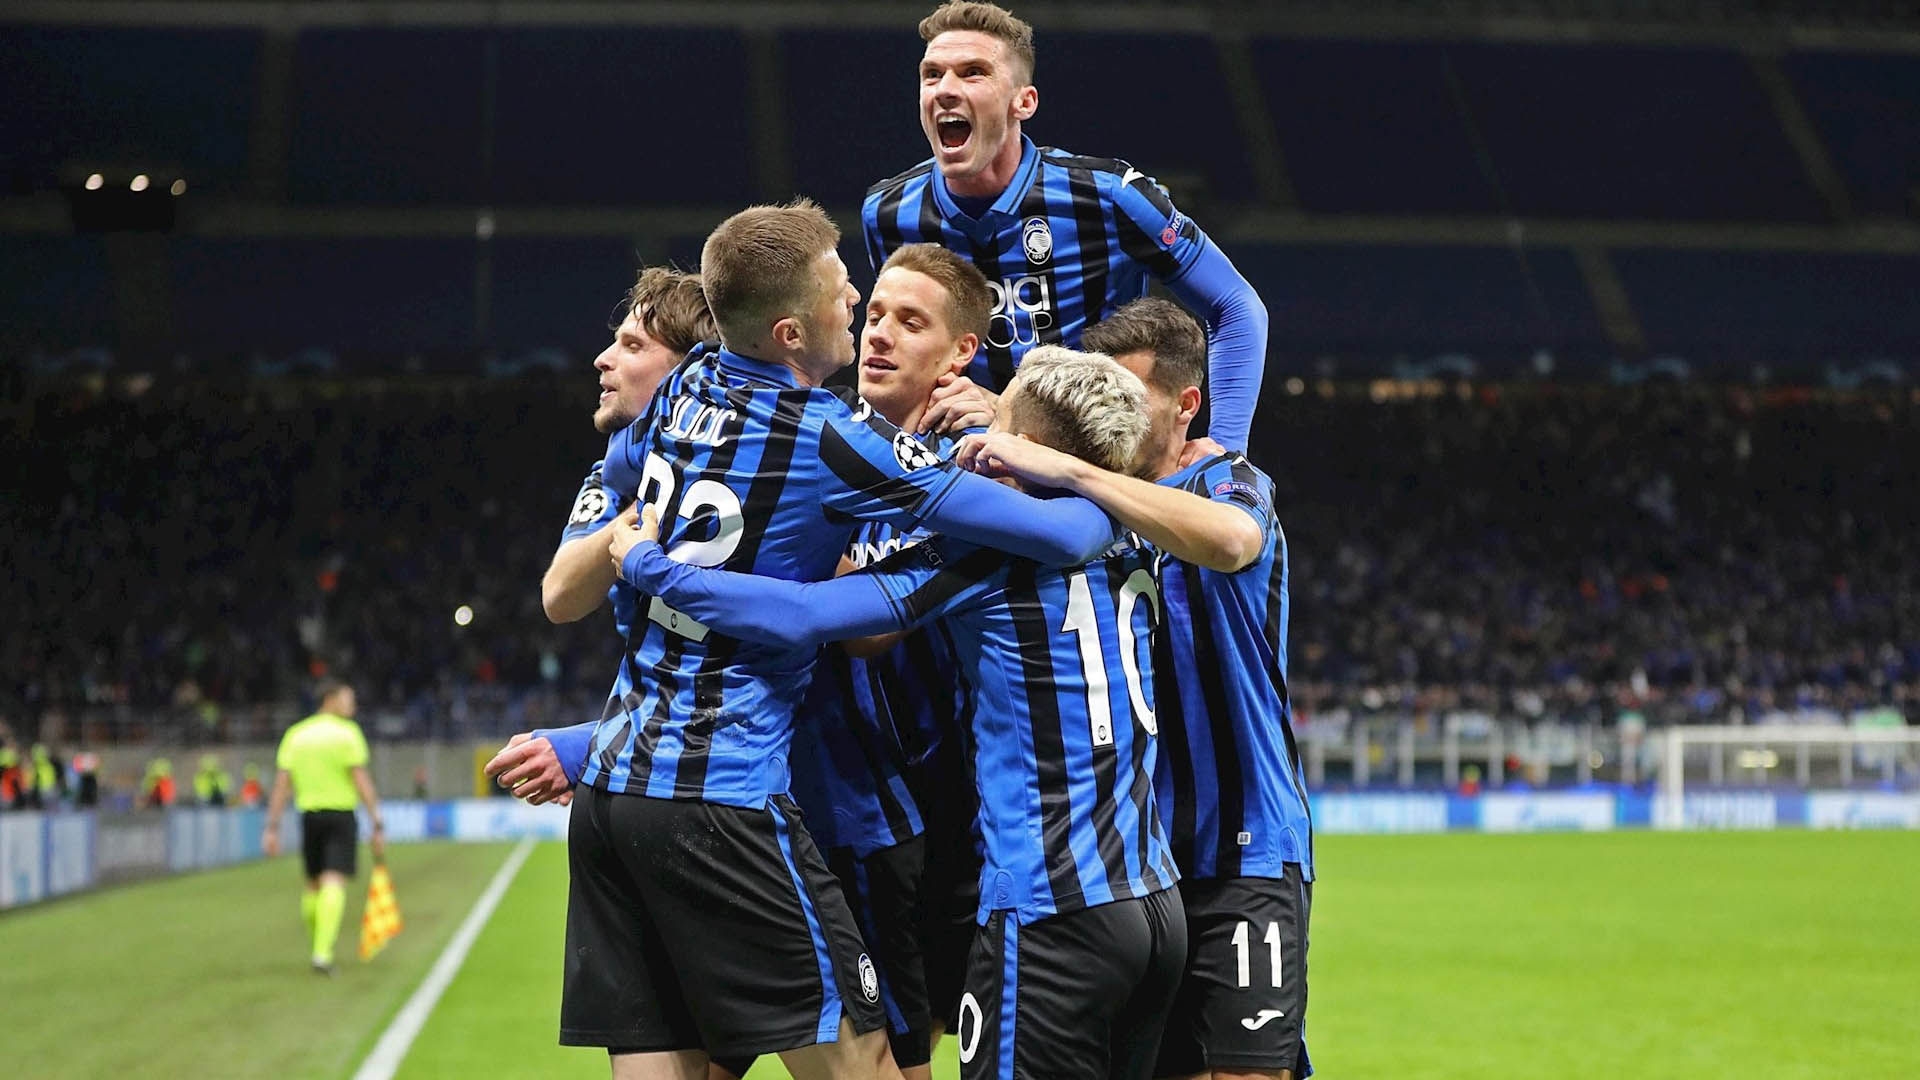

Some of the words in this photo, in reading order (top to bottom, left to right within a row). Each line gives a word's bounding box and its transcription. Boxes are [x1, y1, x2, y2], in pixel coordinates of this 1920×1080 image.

[983, 310, 1053, 350] OUP
[1231, 921, 1283, 988] 11
[958, 992, 983, 1064] 0
